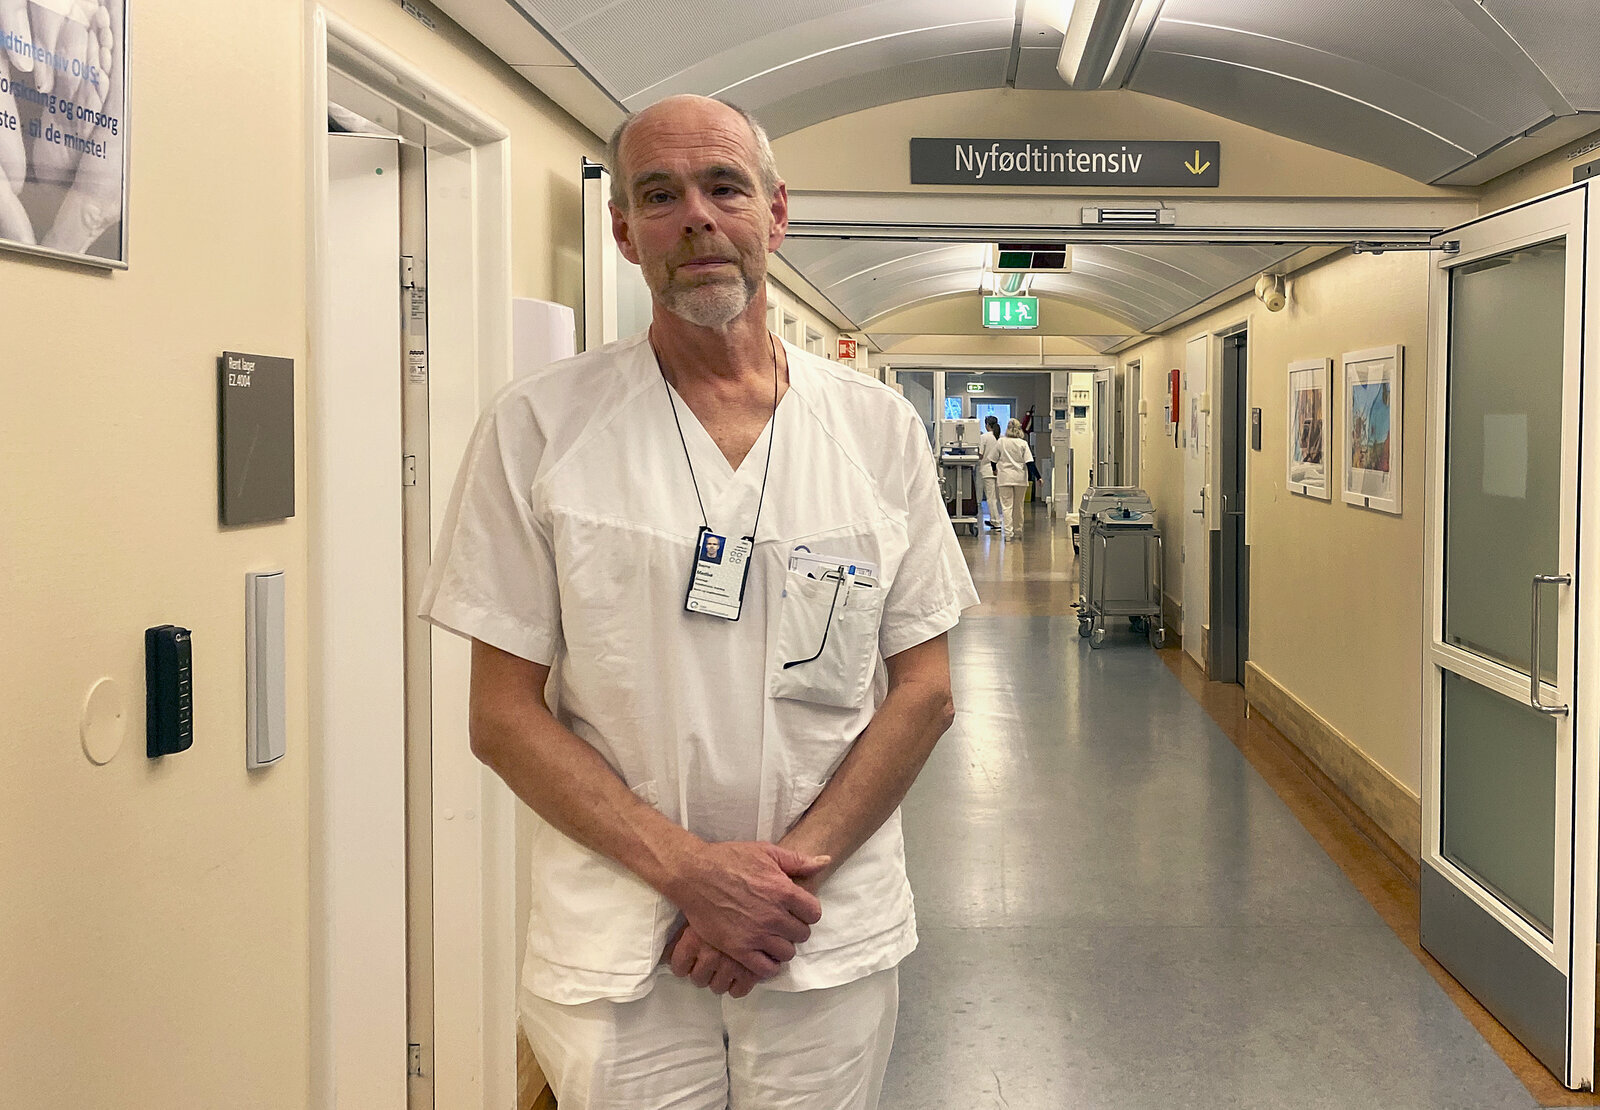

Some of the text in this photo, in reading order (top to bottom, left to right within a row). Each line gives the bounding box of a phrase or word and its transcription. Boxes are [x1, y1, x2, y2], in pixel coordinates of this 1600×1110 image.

[0, 77, 118, 136] orskning og omsorg
[29, 118, 42, 139] til
[45, 123, 61, 144] de
[64, 132, 106, 160] minste!
[955, 143, 1142, 179] Nyfødtintensiv
[229, 356, 255, 374] Rent lager
